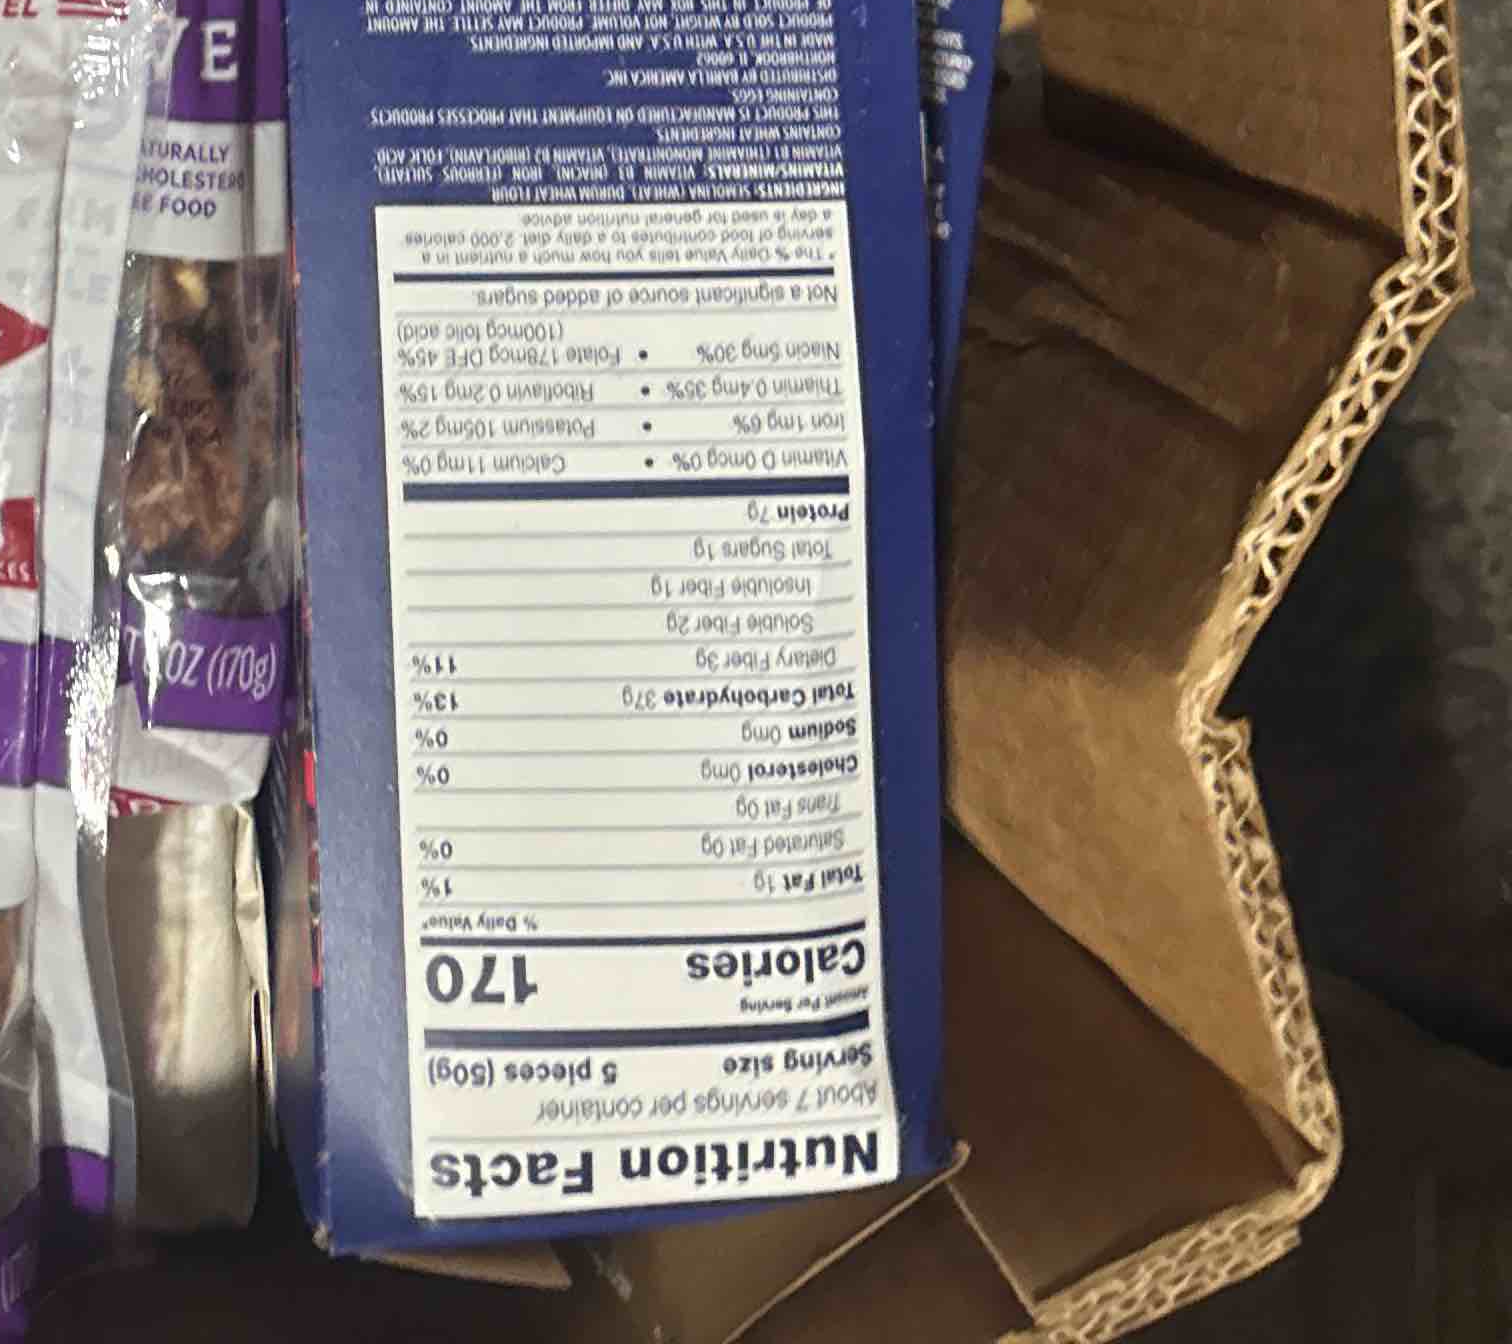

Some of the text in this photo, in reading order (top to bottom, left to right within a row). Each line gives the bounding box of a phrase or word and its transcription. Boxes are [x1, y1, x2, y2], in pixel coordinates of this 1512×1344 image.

[159, 196, 217, 218] FOOD
[396, 321, 564, 343] (100mcg folic acid)
[397, 344, 621, 367] Folate 178mcg DFE 45%
[747, 500, 849, 522] Protein 7g
[650, 575, 812, 598] Insoluble Fiber 1g
[666, 611, 813, 634] Soluble Fiber 2g
[205, 639, 277, 698] (170g)
[412, 654, 457, 674] 11%
[695, 645, 836, 672] Dietary Fiber 3g
[413, 691, 458, 711] 13%
[621, 681, 854, 710] Total Carbohydrate 37g
[414, 728, 448, 748] 0%
[741, 718, 857, 744] Sodium 0mg
[416, 765, 450, 784] 0%
[700, 755, 858, 782] Cholesterol 0mg
[420, 838, 452, 859] 0%
[421, 877, 452, 896] 1%
[753, 864, 863, 892] Total Fat 1g
[685, 942, 864, 984] Calories
[425, 954, 538, 1003] 170
[427, 1056, 618, 1086] 5 pieces (50g)
[722, 1042, 872, 1078] Serving size
[535, 1082, 878, 1124] About 7 servings per container
[428, 1133, 878, 1197] Nutrition Facts
